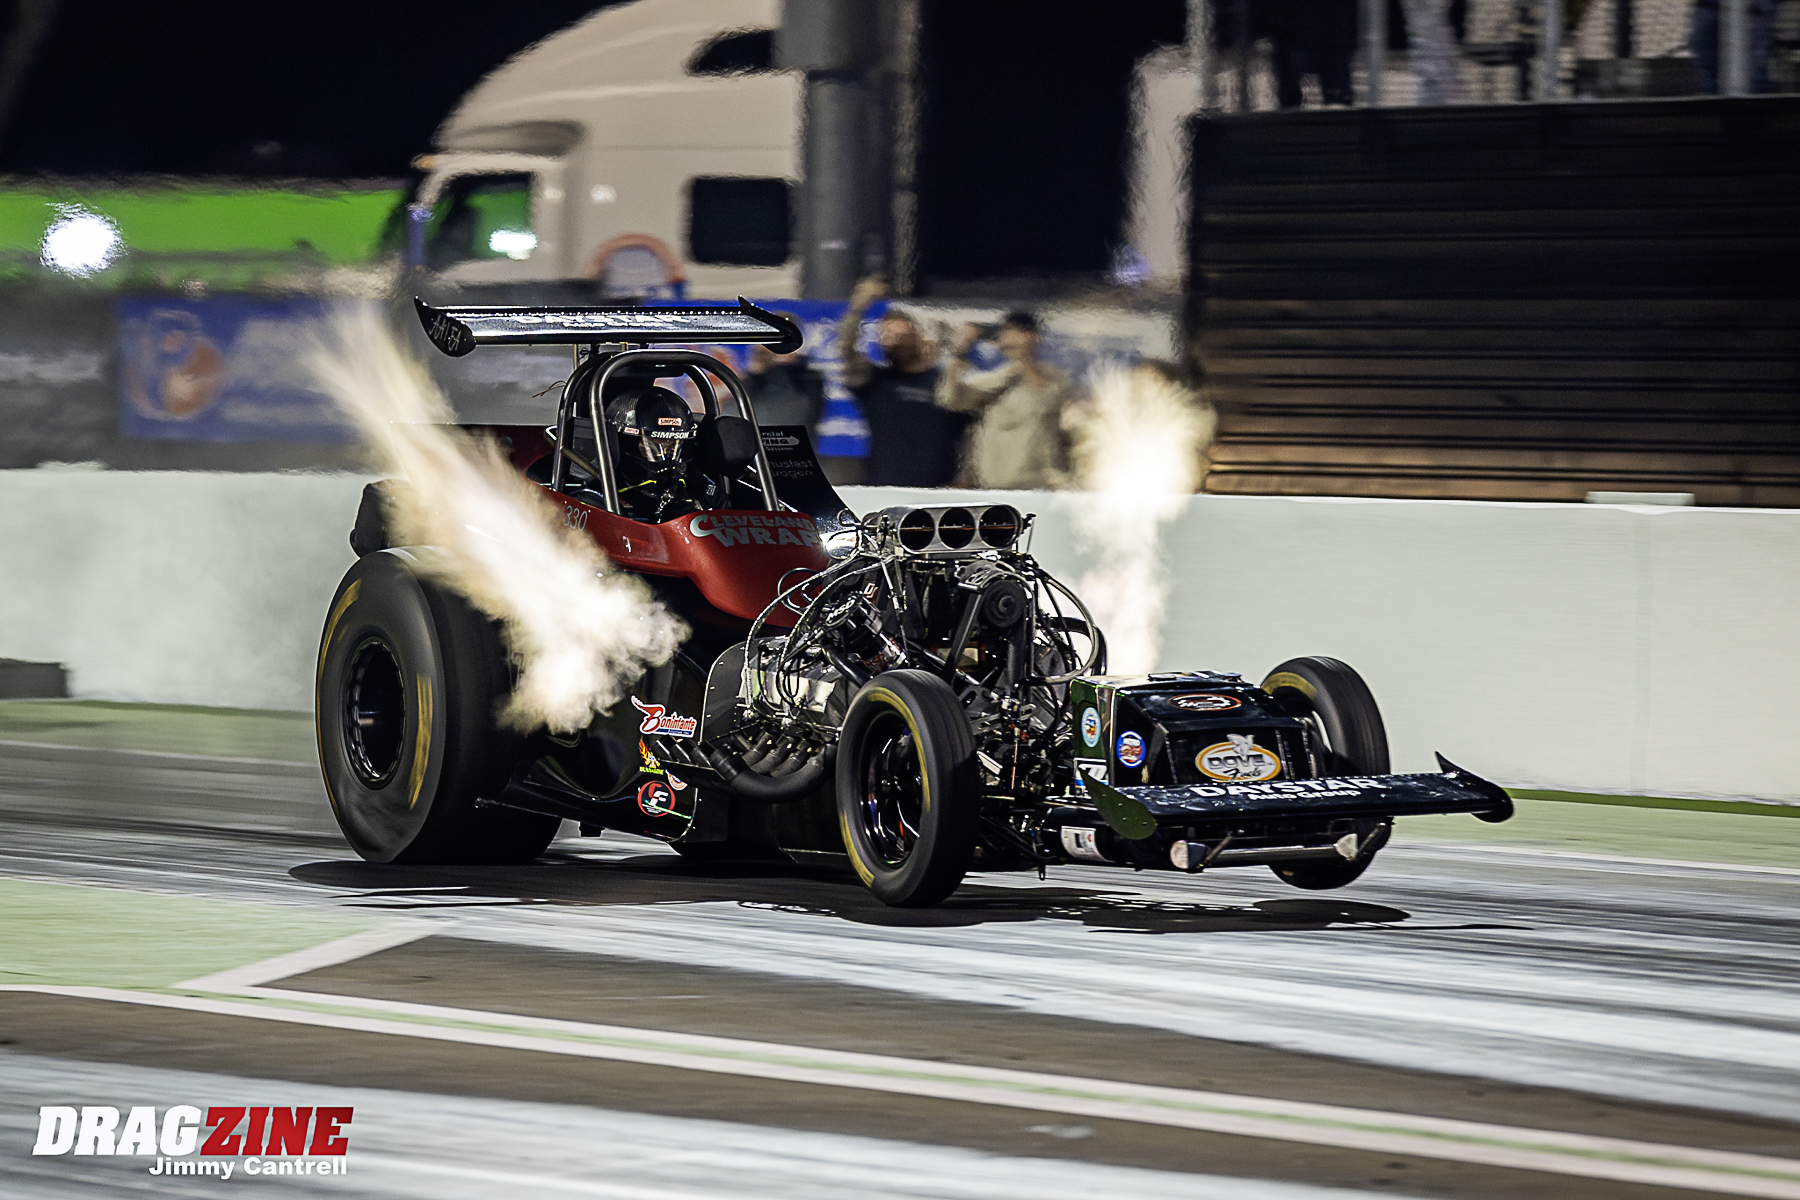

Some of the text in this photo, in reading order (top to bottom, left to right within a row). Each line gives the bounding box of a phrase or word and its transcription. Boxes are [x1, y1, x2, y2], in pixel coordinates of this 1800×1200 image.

[650, 430, 689, 439] SIMPSON
[562, 505, 588, 532] 330
[689, 514, 815, 538] CLEVELAND
[1207, 753, 1266, 770] DOVE
[1189, 778, 1388, 798] DAYSTAR
[1247, 789, 1362, 801] Auto Group
